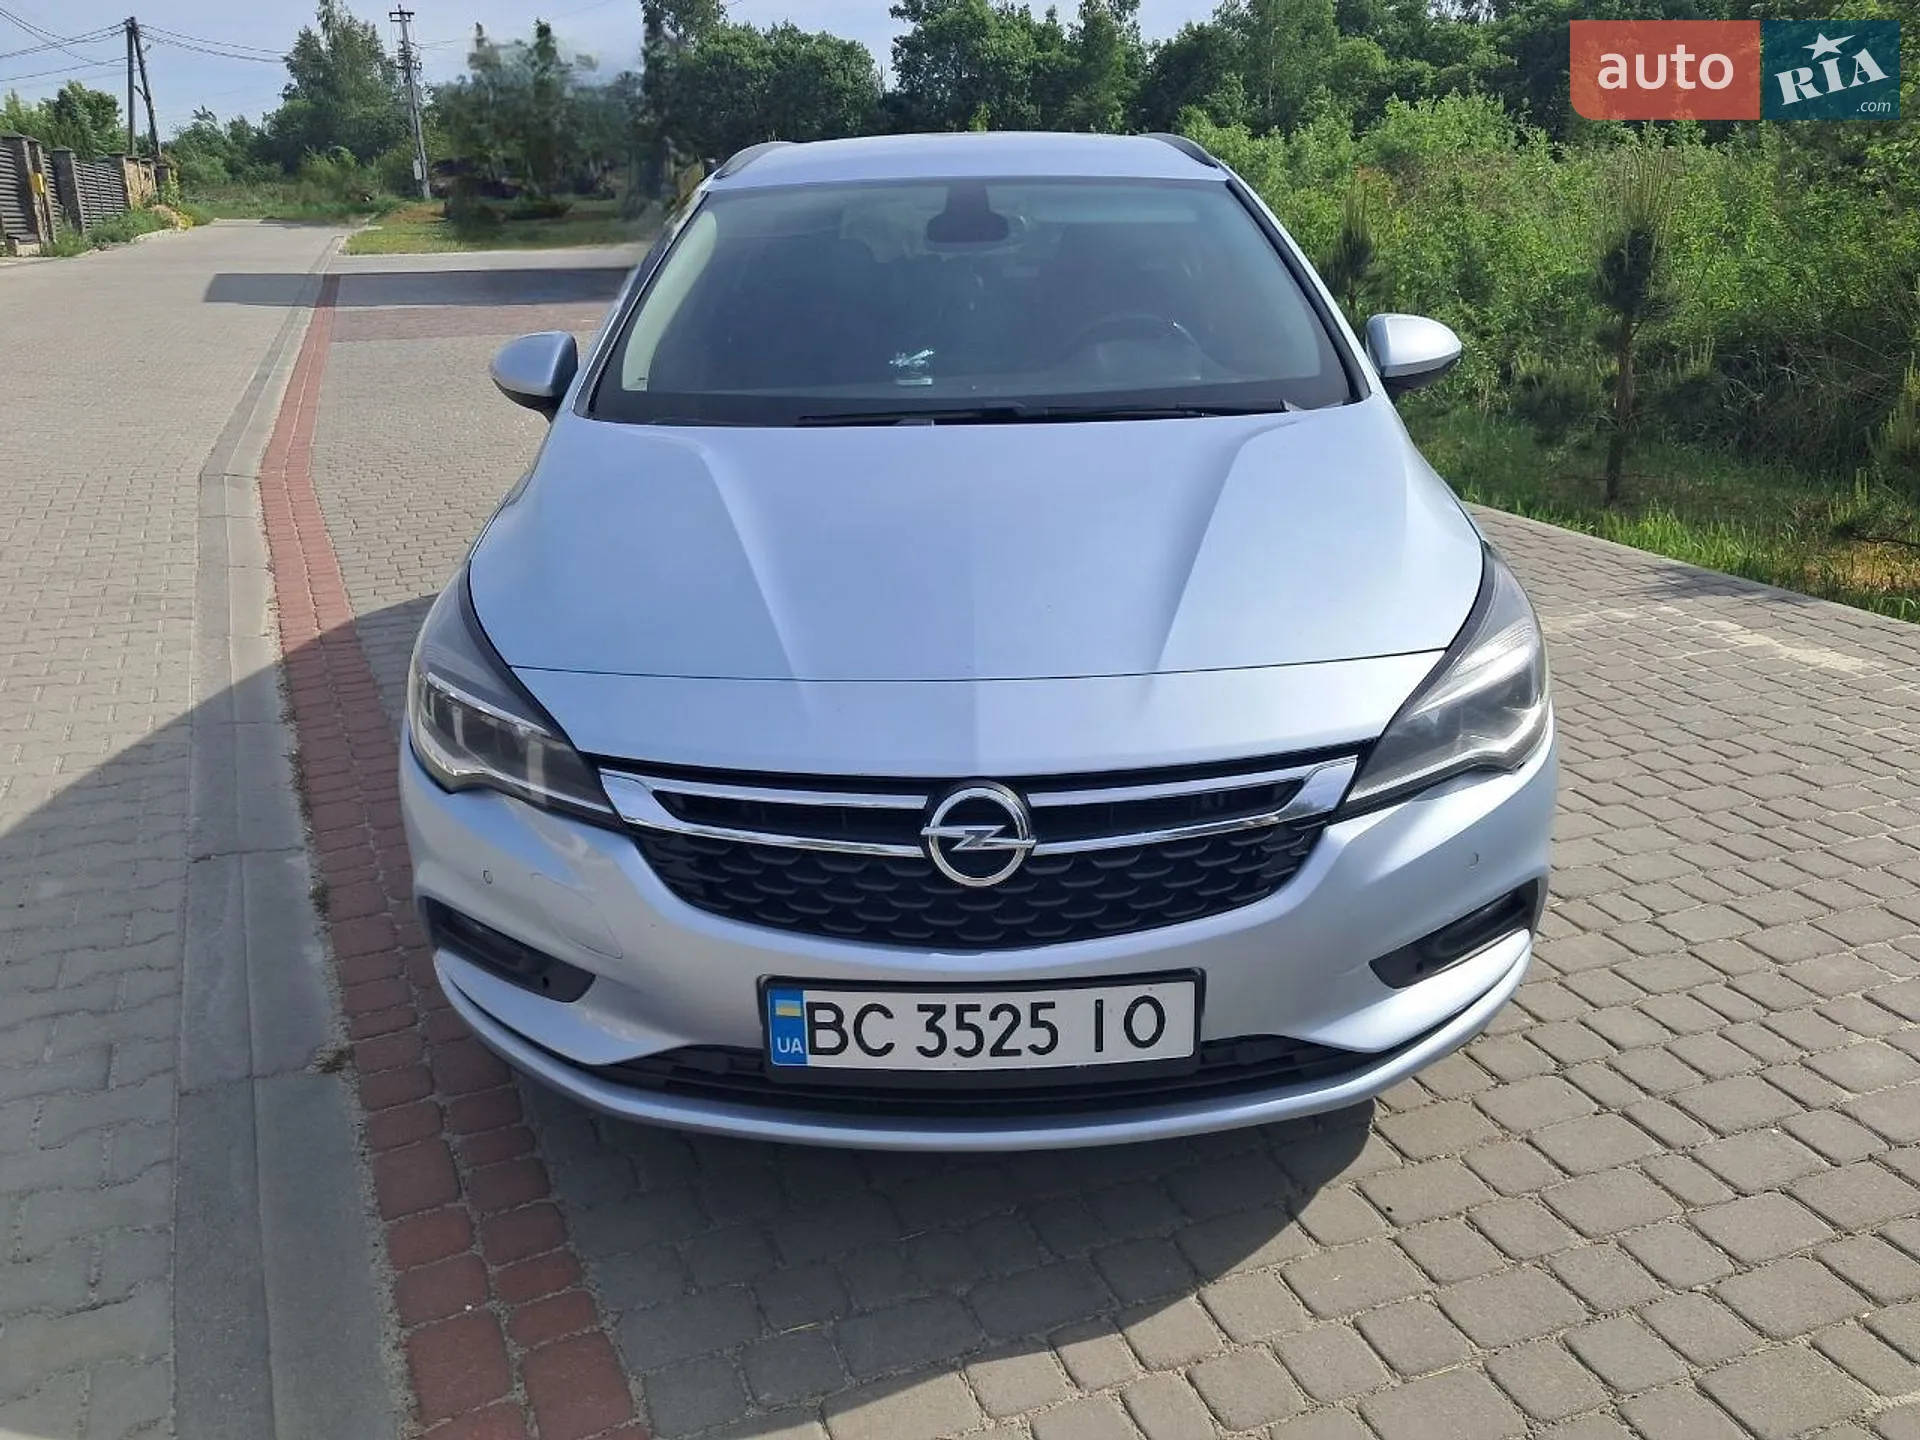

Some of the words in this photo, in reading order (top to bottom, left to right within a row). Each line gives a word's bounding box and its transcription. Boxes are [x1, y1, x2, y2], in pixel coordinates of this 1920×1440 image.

[777, 1037, 803, 1054] UA
[806, 1001, 895, 1057] BC
[916, 1001, 1059, 1058] 3525
